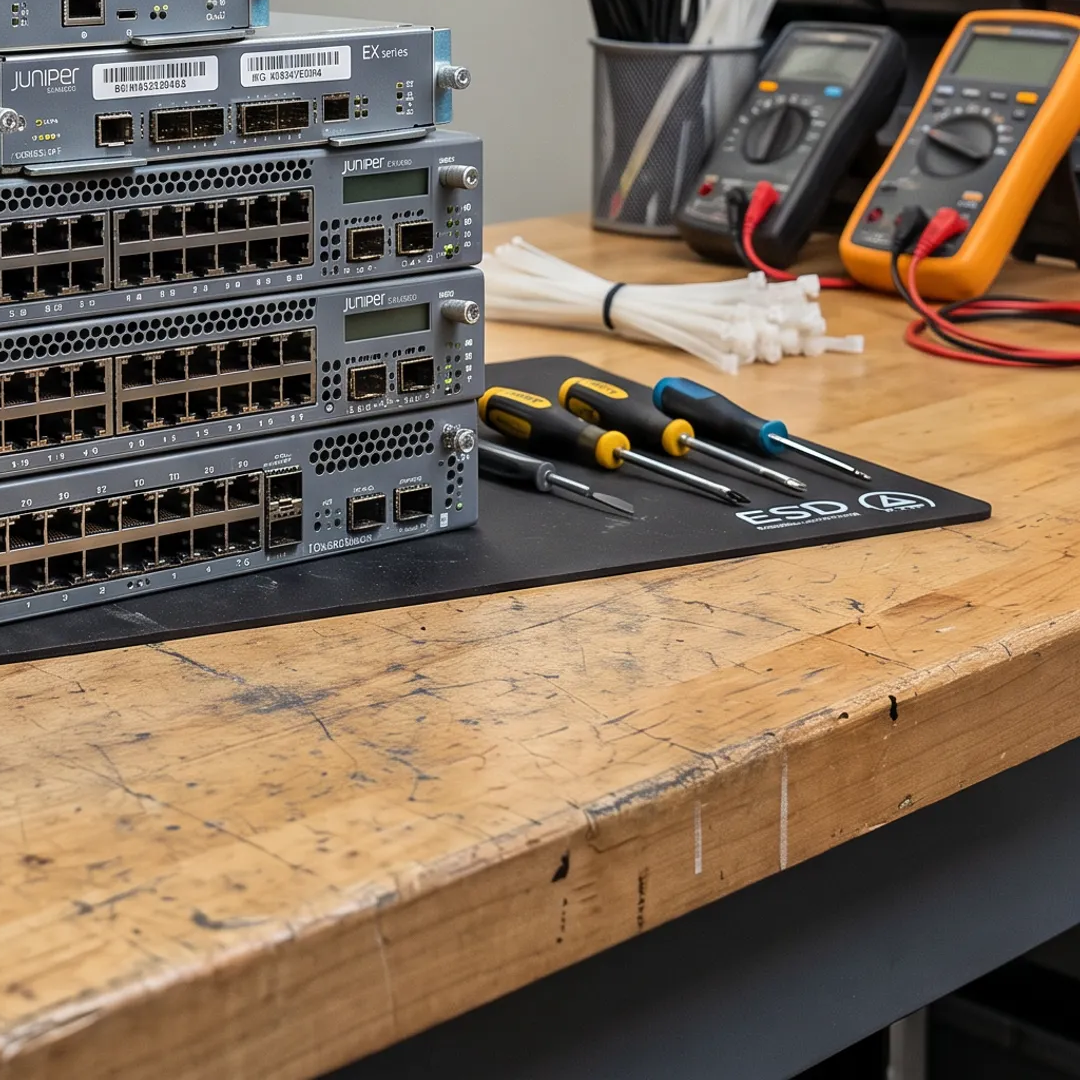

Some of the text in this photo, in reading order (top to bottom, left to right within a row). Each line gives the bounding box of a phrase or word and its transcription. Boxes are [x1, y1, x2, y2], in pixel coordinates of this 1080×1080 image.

[363, 45, 408, 60] EX series
[735, 500, 849, 525] ESD
